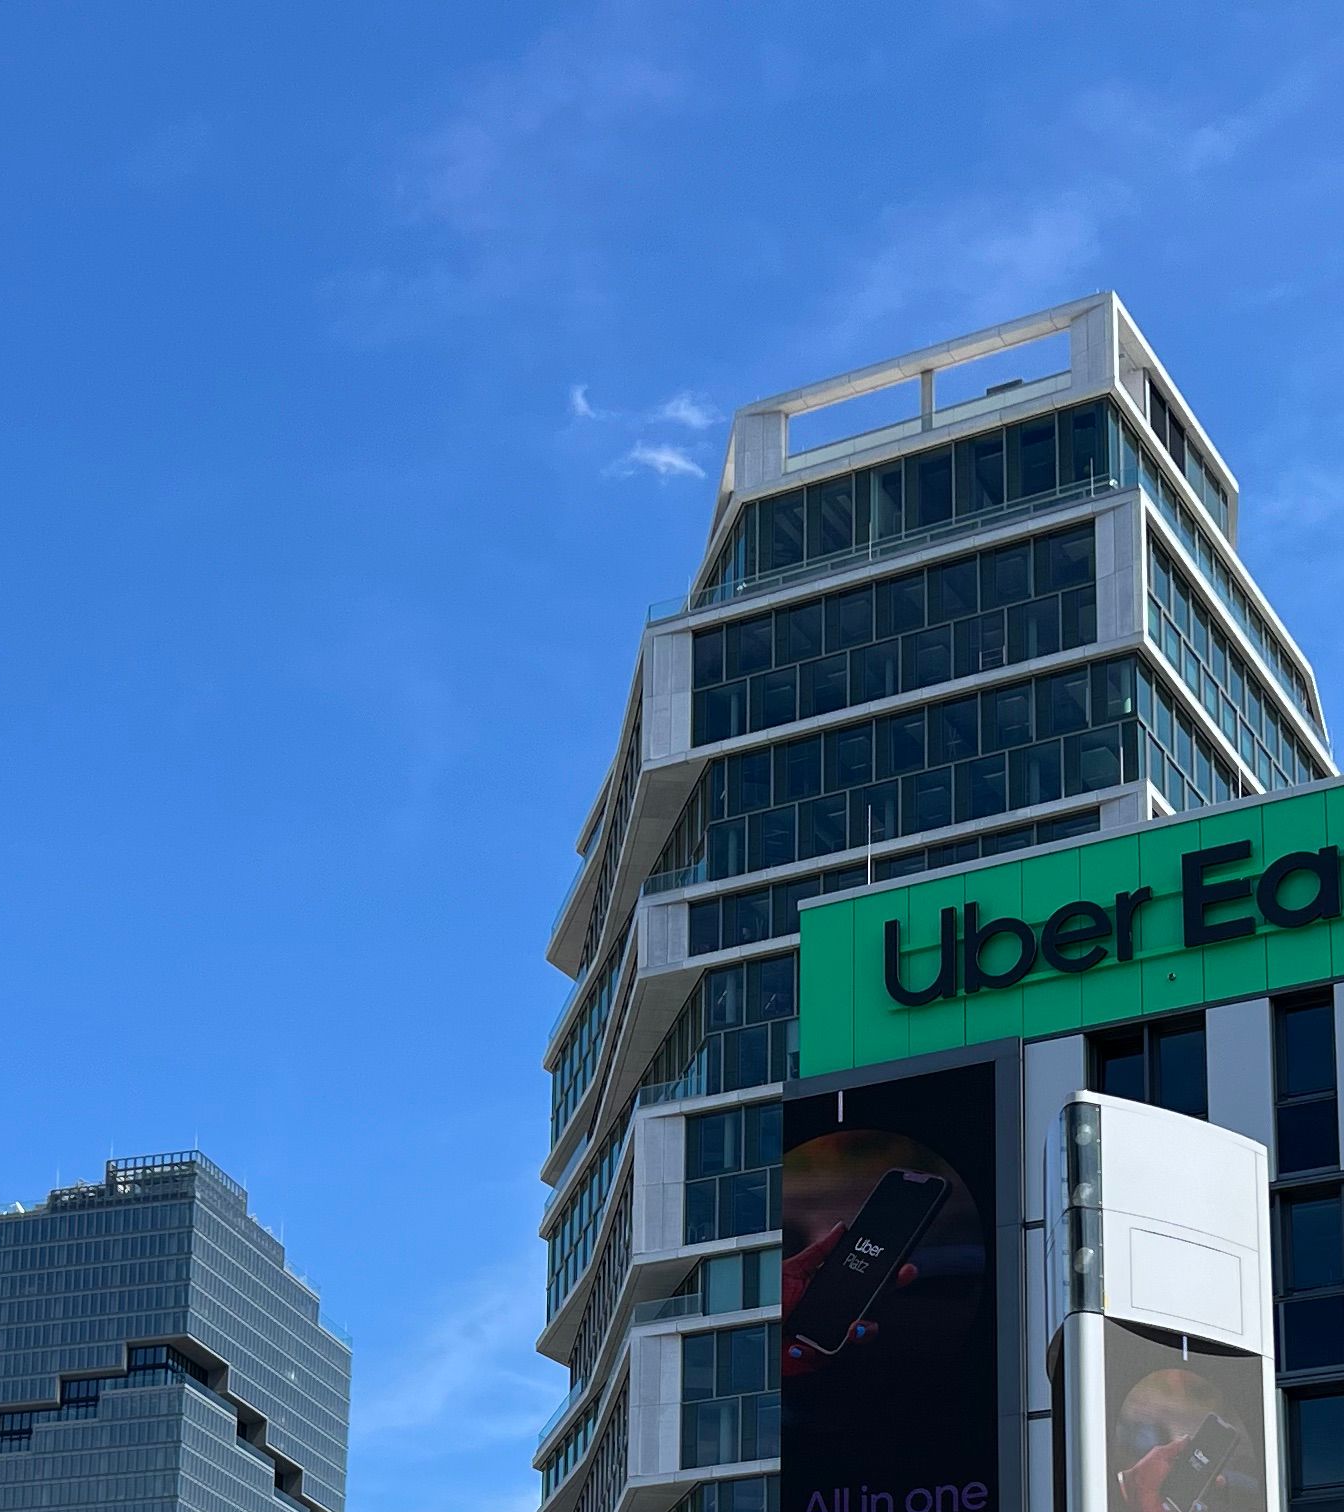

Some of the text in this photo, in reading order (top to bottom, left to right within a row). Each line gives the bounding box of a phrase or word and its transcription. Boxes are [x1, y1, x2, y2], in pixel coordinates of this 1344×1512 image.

[884, 885, 1152, 1007] Uber
[855, 1236, 884, 1257] Uber
[843, 1253, 869, 1273] Platz
